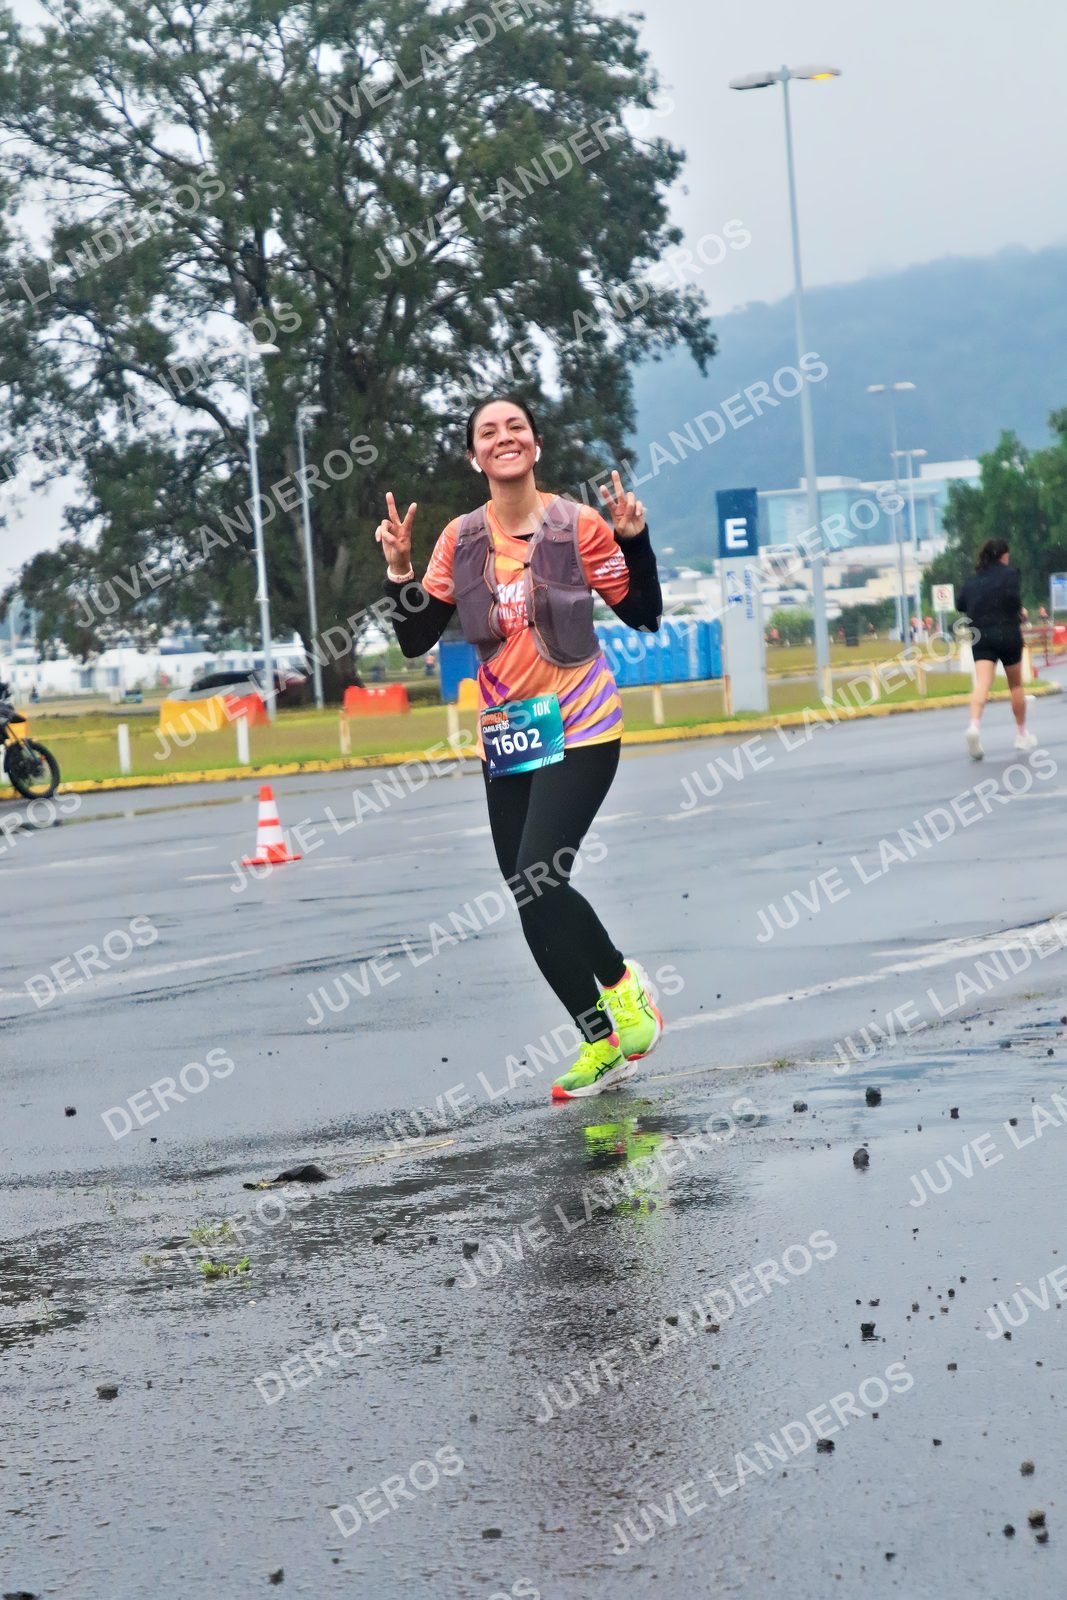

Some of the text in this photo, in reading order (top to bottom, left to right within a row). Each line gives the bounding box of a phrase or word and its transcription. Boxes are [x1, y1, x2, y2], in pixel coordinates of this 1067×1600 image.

[725, 517, 749, 549] E
[532, 700, 551, 717] 10K
[492, 728, 542, 756] 1602
